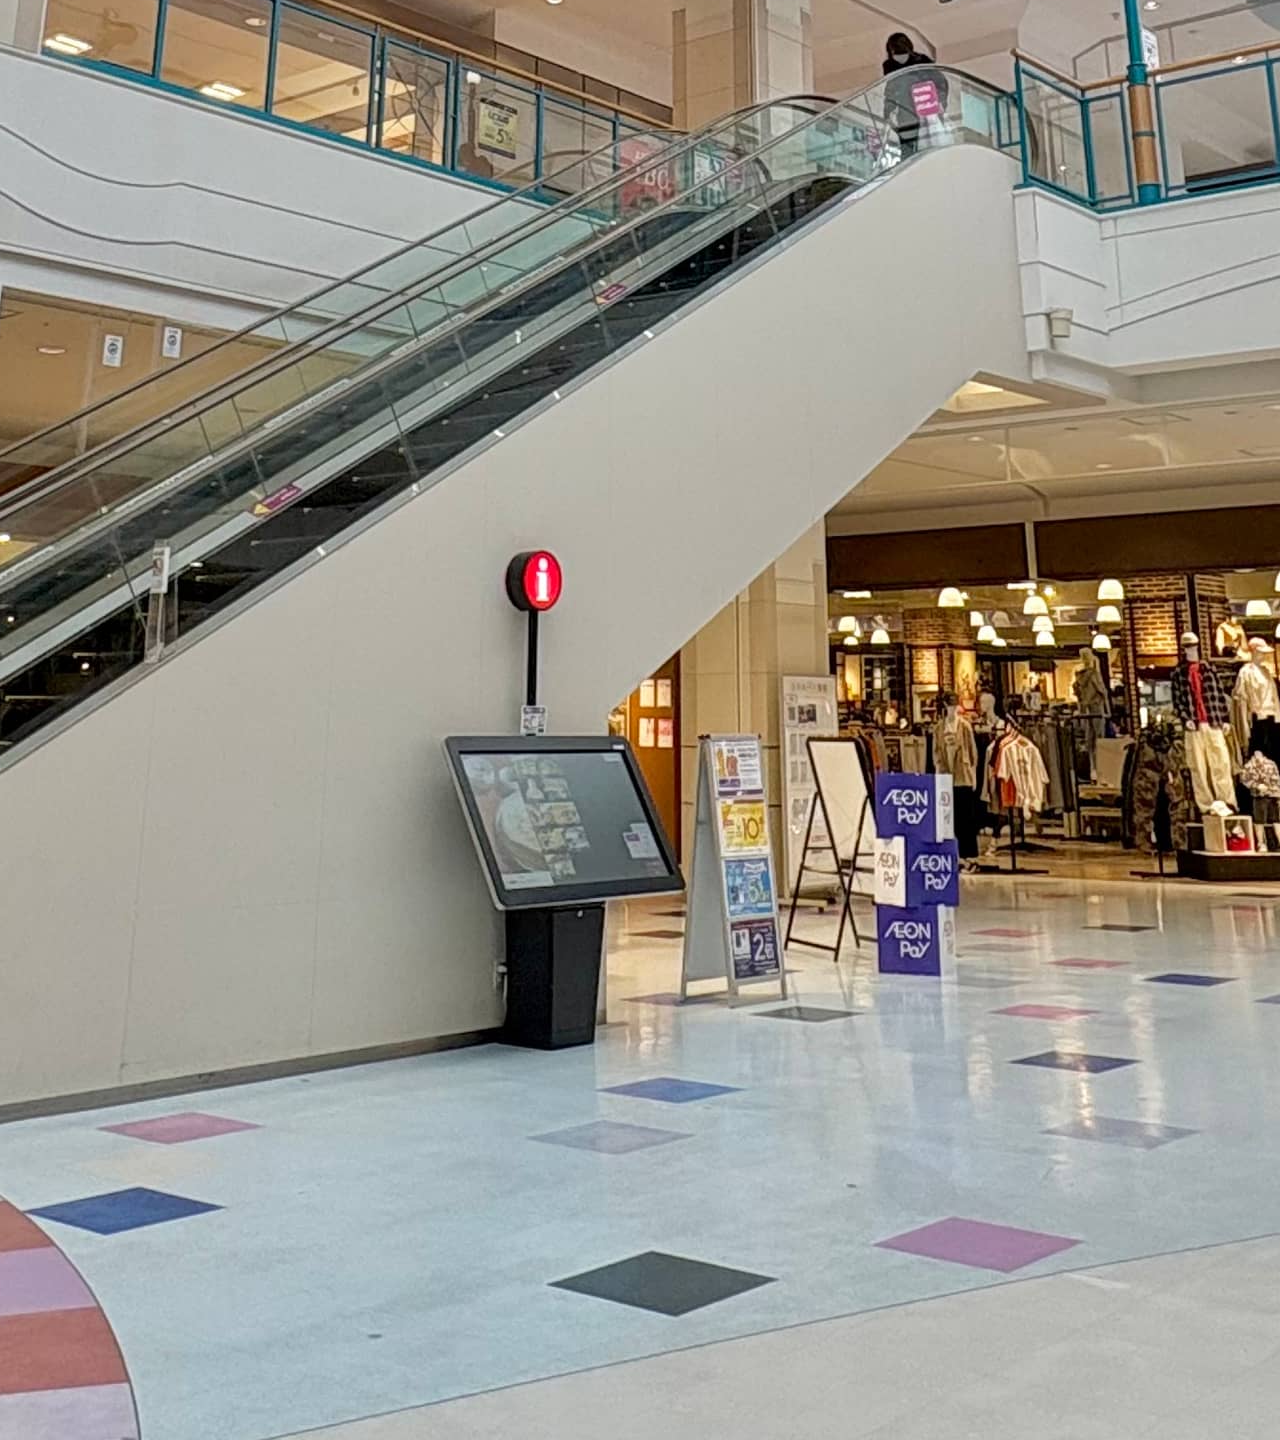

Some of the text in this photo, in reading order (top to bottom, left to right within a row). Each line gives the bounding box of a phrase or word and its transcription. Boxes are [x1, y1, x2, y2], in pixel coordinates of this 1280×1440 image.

[897, 807, 928, 825] Pay
[924, 873, 952, 891] Pay
[900, 940, 931, 958] Pay
